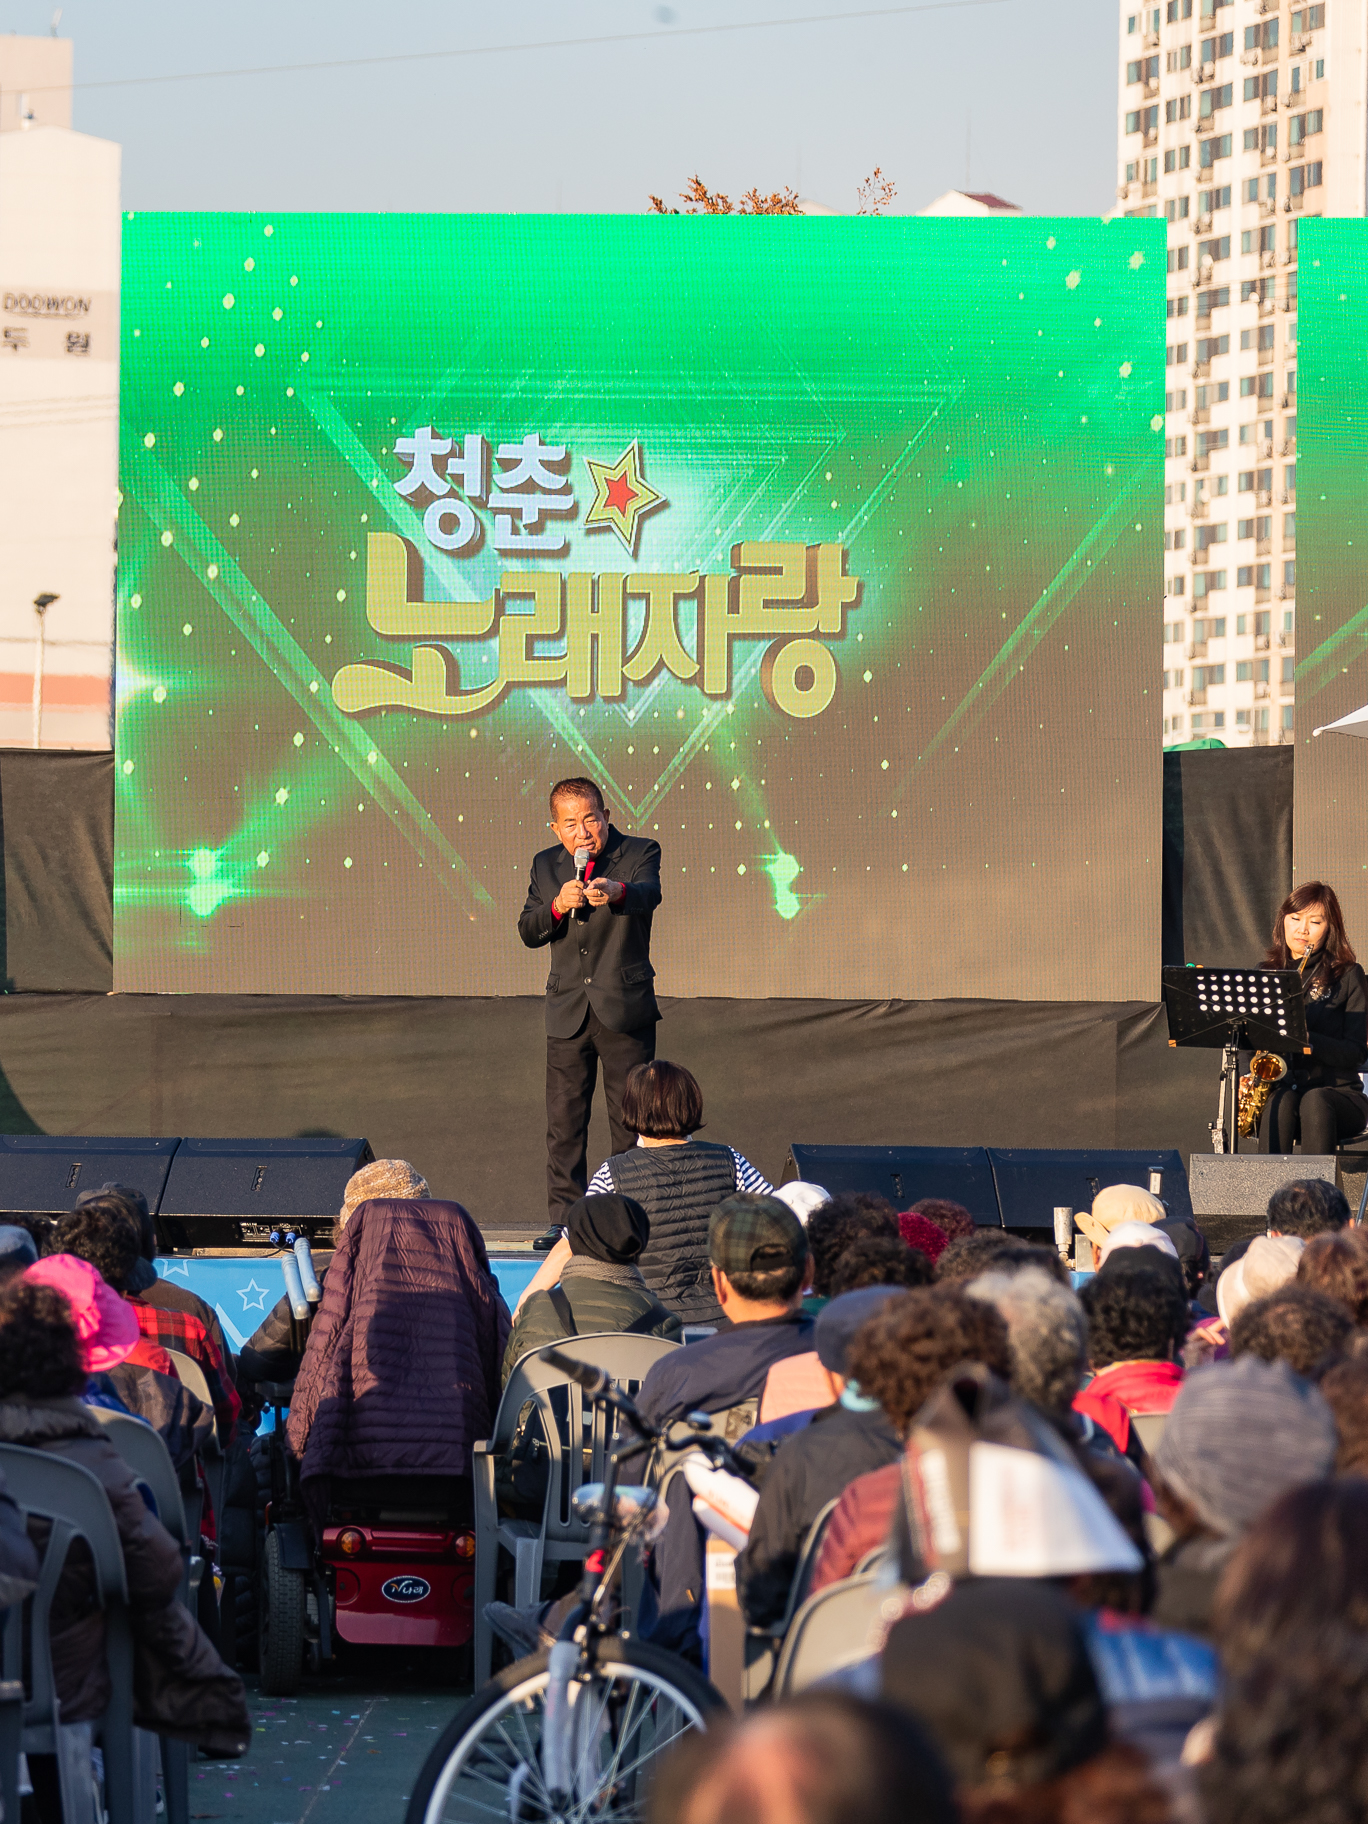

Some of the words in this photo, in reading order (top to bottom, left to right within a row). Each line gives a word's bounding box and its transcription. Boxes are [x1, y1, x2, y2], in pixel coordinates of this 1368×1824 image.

[2, 293, 92, 313] DOOWON
[393, 426, 574, 550] 청춘
[332, 532, 861, 718] 노래자랑
